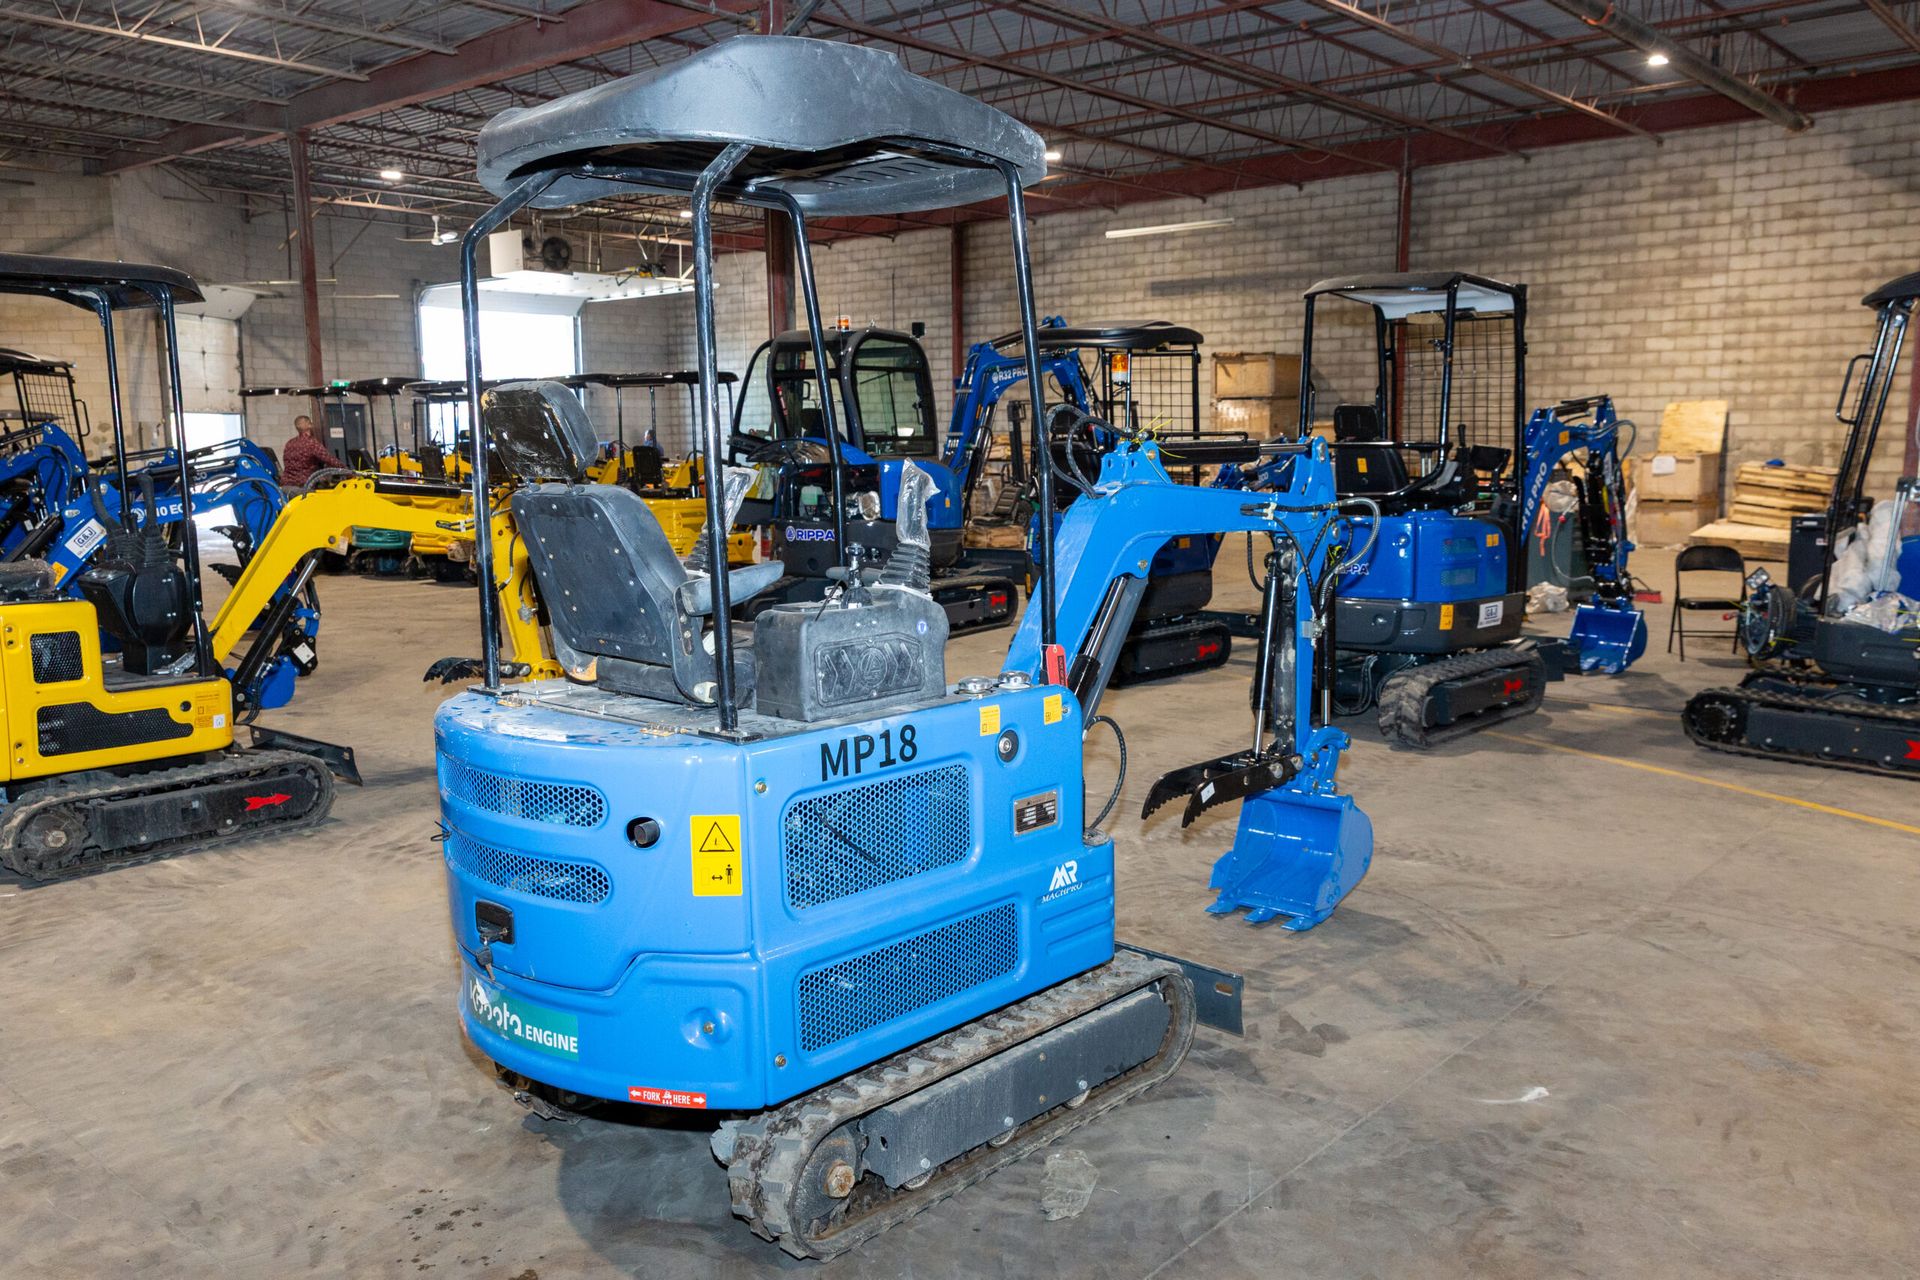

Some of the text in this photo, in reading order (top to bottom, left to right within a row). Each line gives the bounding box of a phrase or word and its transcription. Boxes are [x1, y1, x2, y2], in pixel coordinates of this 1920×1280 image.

[1531, 462, 1547, 498] PRO
[147, 506, 168, 518] 10
[77, 529, 94, 545] G&J
[795, 528, 835, 541] RIPPA
[820, 724, 918, 782] MP18
[1041, 882, 1083, 904] MACHPRO
[525, 1024, 578, 1053] ENGINE
[643, 1090, 691, 1105] FORK HERE
